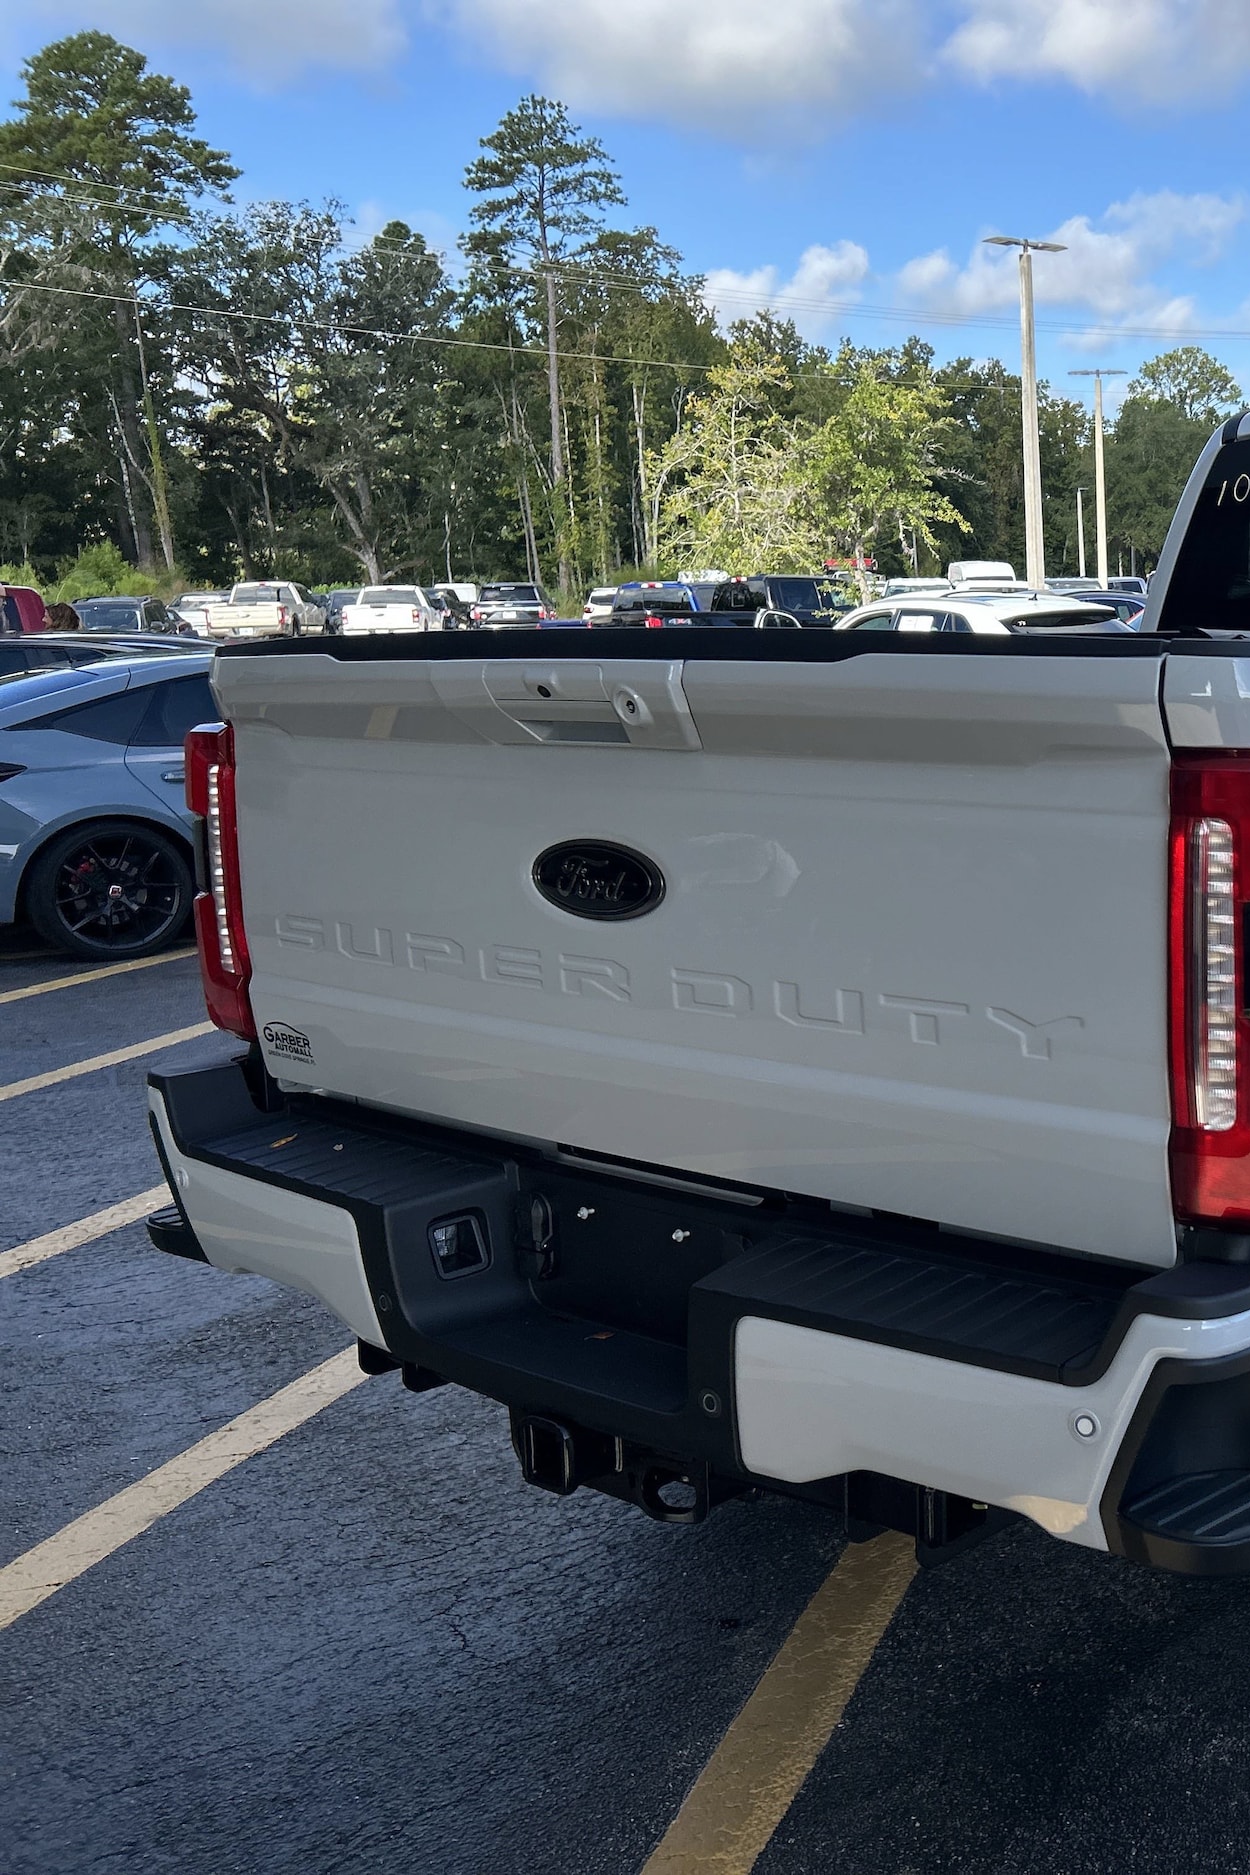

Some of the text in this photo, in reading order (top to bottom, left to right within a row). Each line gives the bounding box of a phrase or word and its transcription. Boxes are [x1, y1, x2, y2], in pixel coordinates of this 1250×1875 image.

[1217, 473, 1250, 507] 10
[274, 915, 1086, 1061] SUPER DUTY
[263, 1026, 312, 1050] GARBER
[275, 1042, 314, 1058] AUTOMALL
